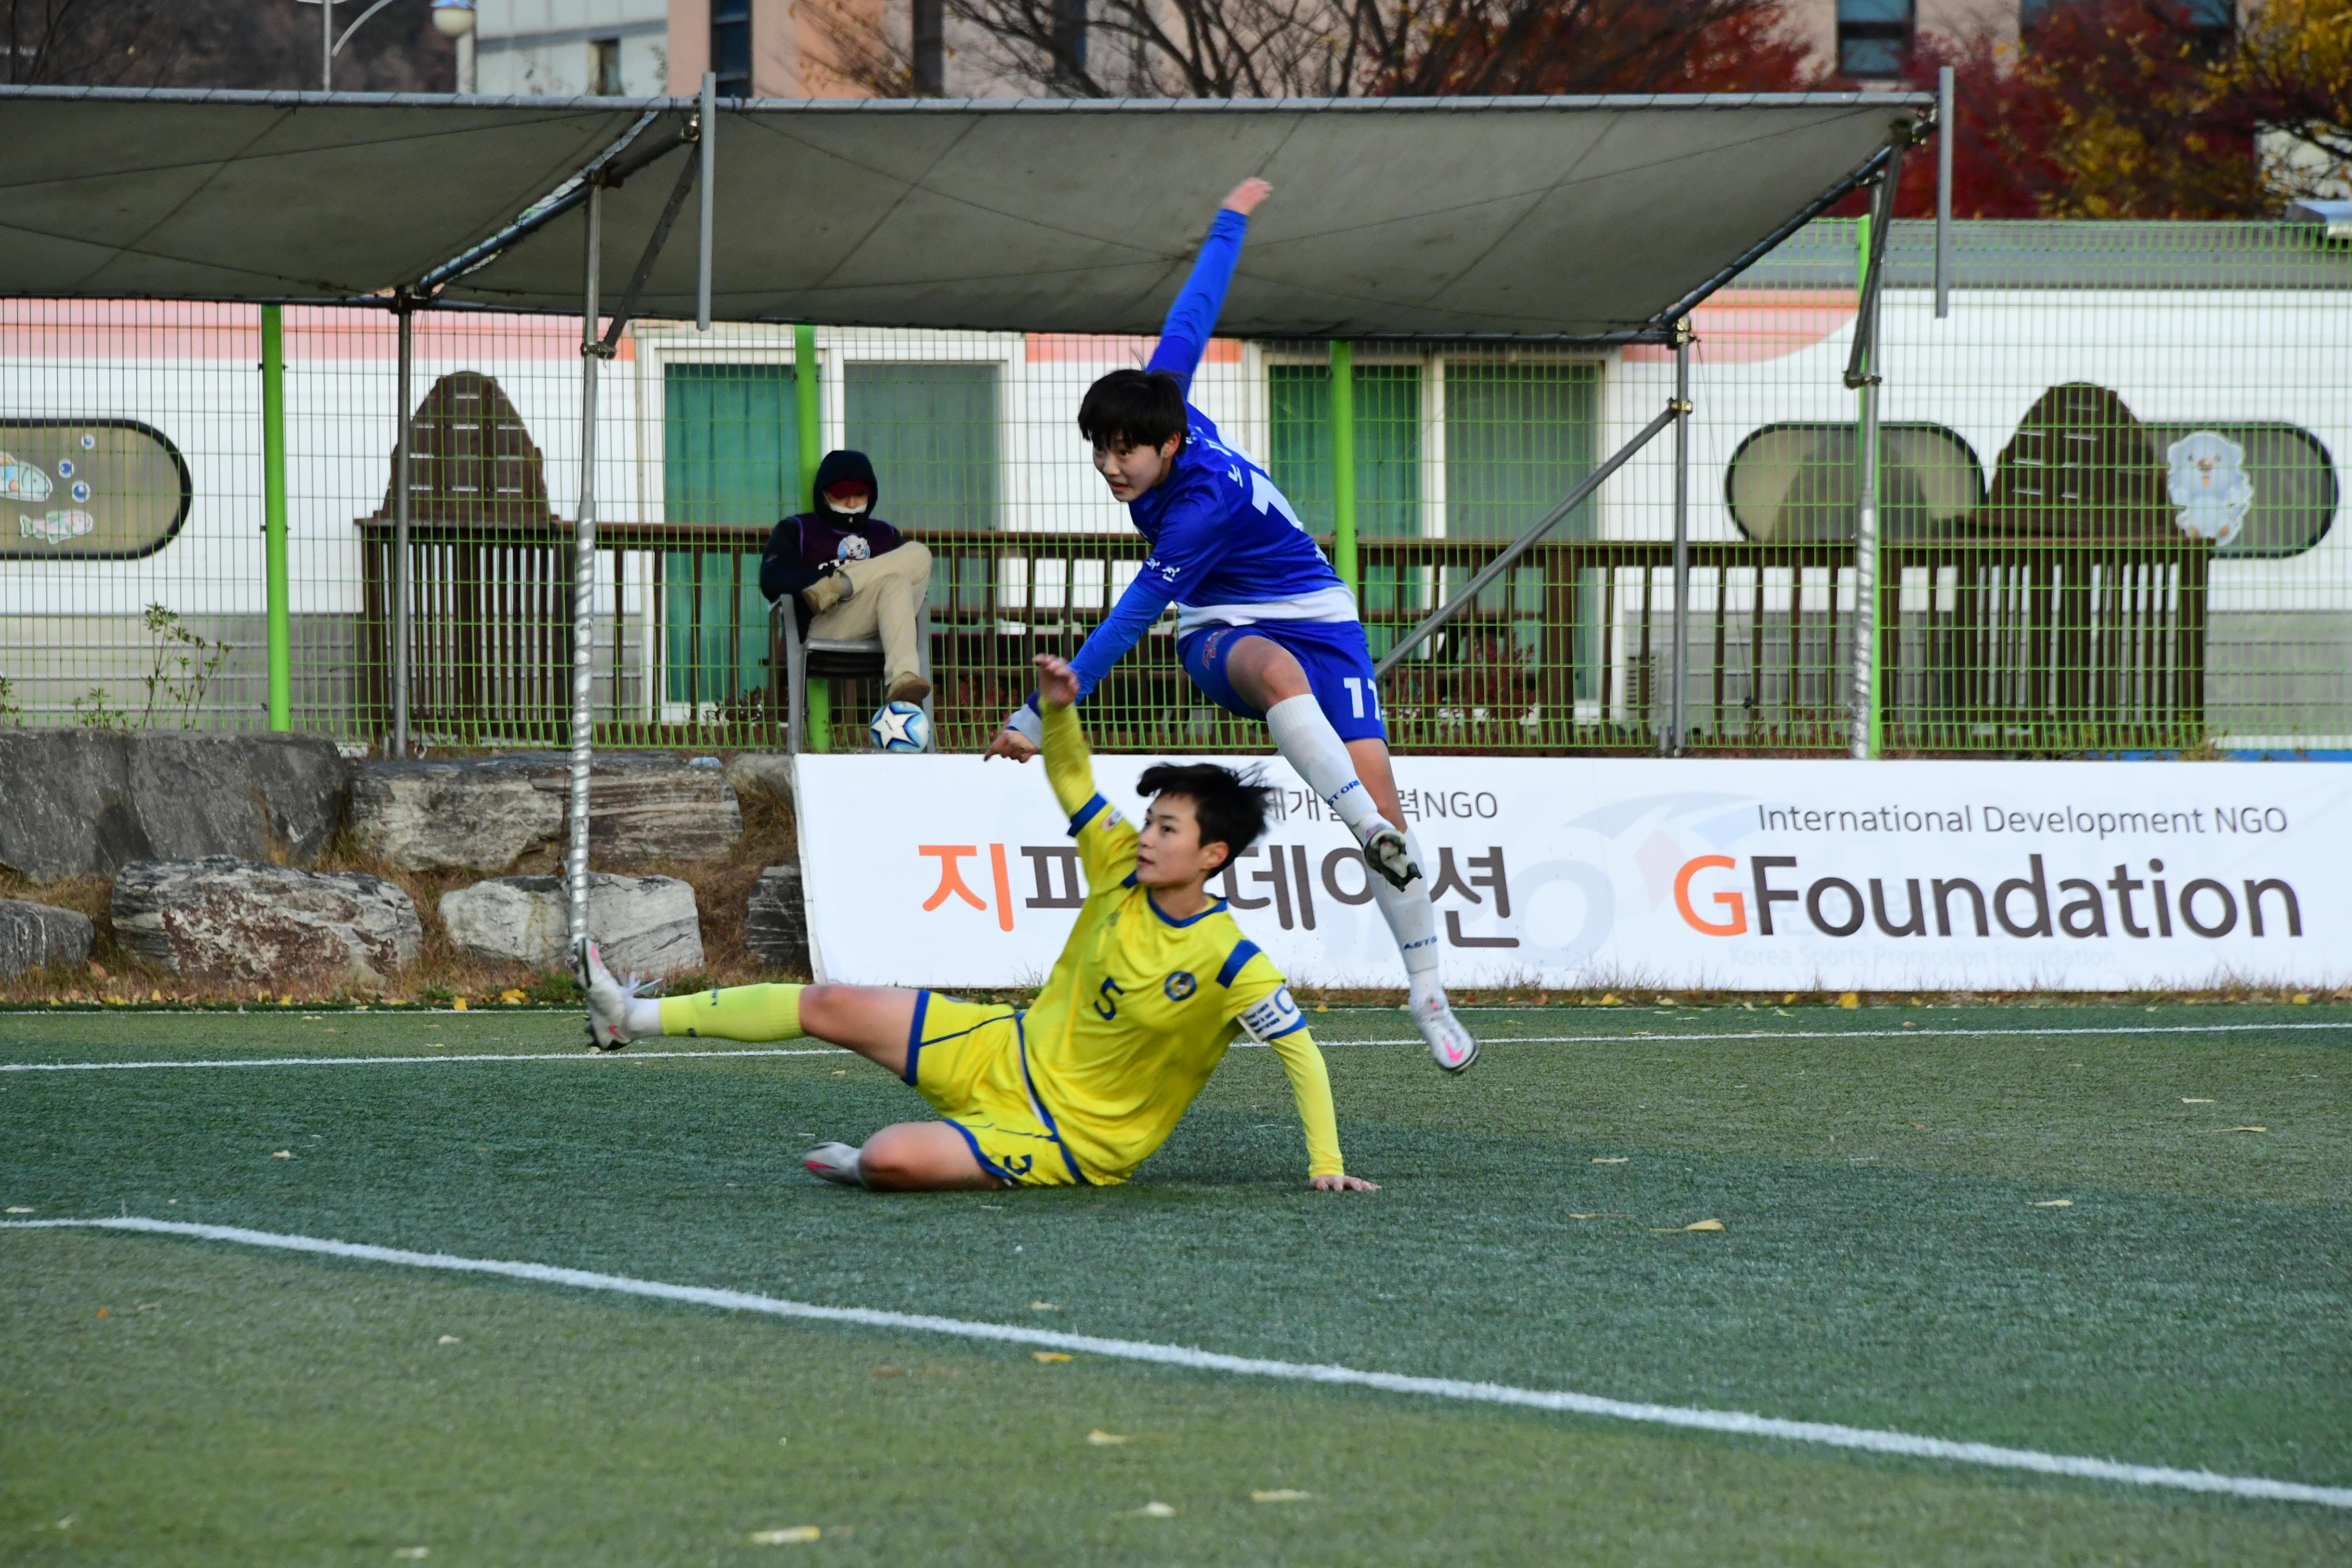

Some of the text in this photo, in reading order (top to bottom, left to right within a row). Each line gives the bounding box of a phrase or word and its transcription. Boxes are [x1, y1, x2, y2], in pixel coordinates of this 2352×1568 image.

[1759, 805, 2287, 840] International Development NGO
[1674, 853, 2303, 939] GFoundation
[1729, 946, 1791, 966] Korea
[1799, 946, 1867, 968] Sports
[1875, 946, 1988, 967] Promotion
[1093, 976, 1124, 1021] 5
